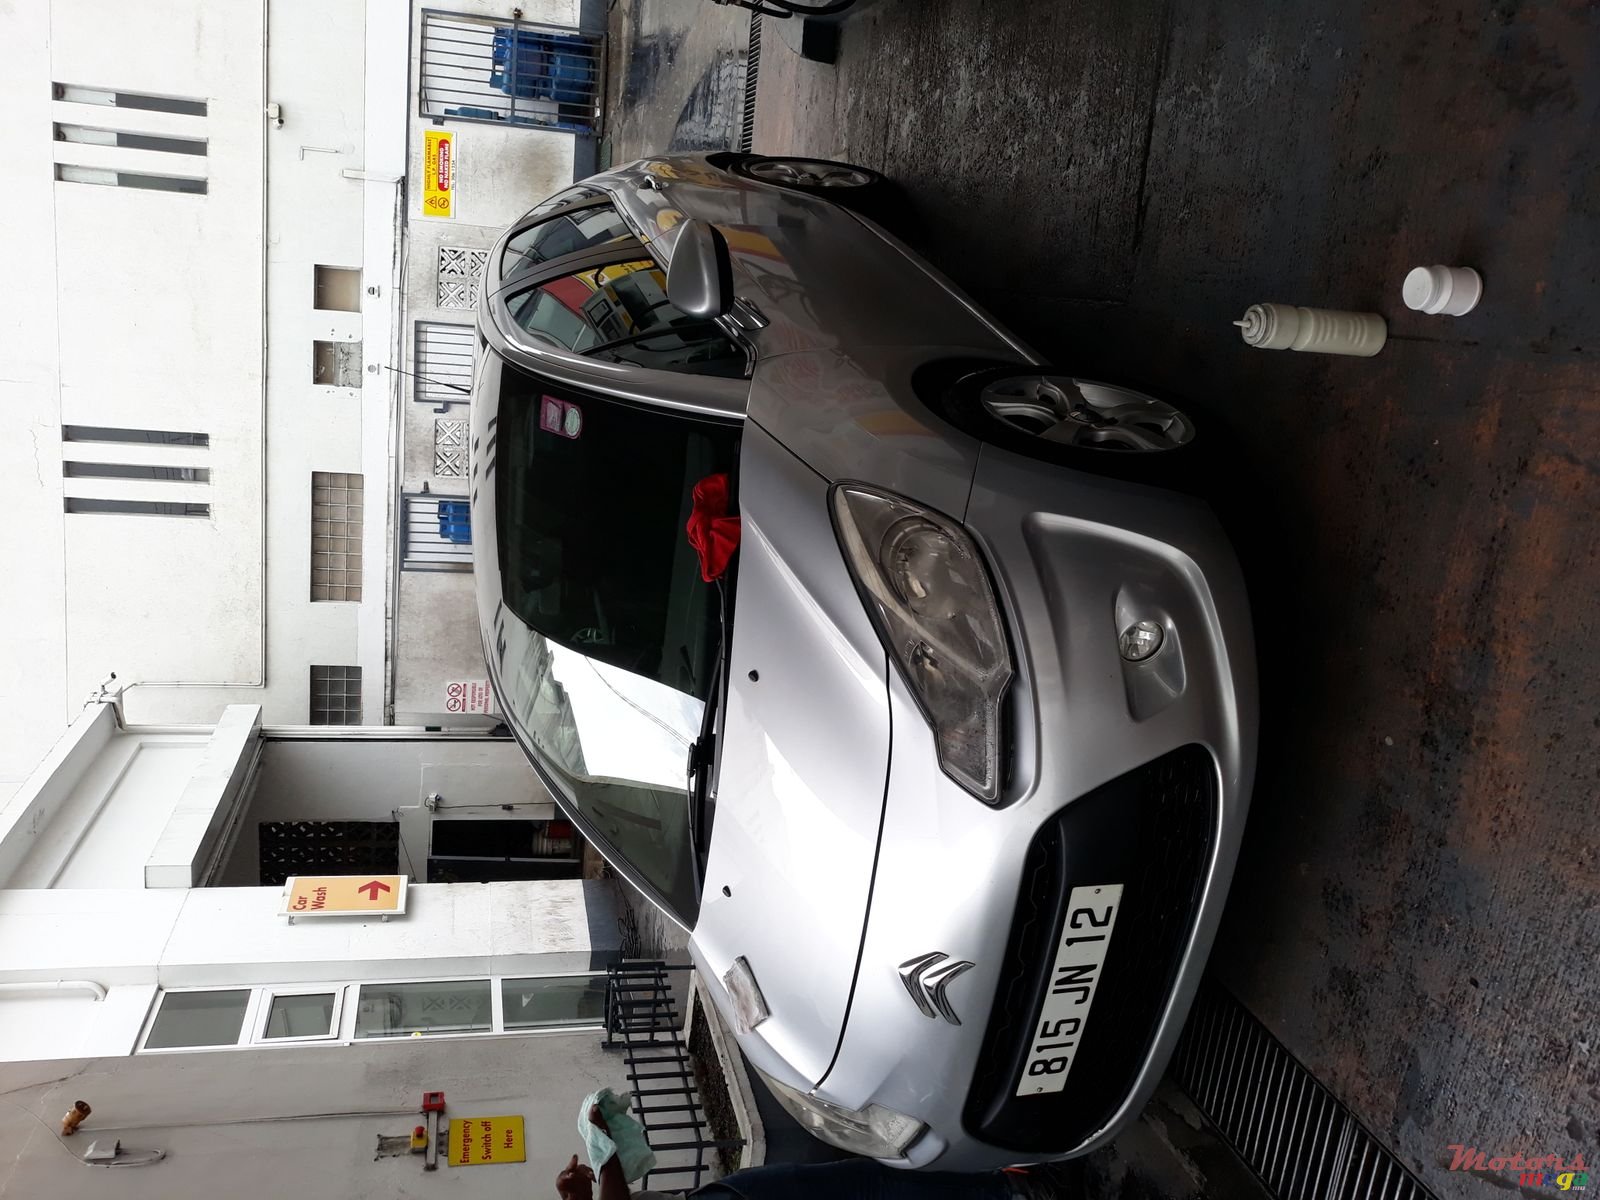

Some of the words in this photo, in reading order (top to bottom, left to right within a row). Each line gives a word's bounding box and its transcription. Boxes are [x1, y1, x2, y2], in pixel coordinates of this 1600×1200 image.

[439, 174, 443, 183] NO
[444, 180, 448, 188] NO
[292, 896, 307, 910] Car
[311, 887, 327, 910] Wash
[1066, 906, 1113, 947] 12
[1052, 964, 1098, 1004] JN
[1028, 1018, 1081, 1076] 815
[481, 1121, 491, 1131] off
[460, 1120, 472, 1163] Emergency
[481, 1134, 491, 1160] Switch
[504, 1130, 512, 1148] Here
